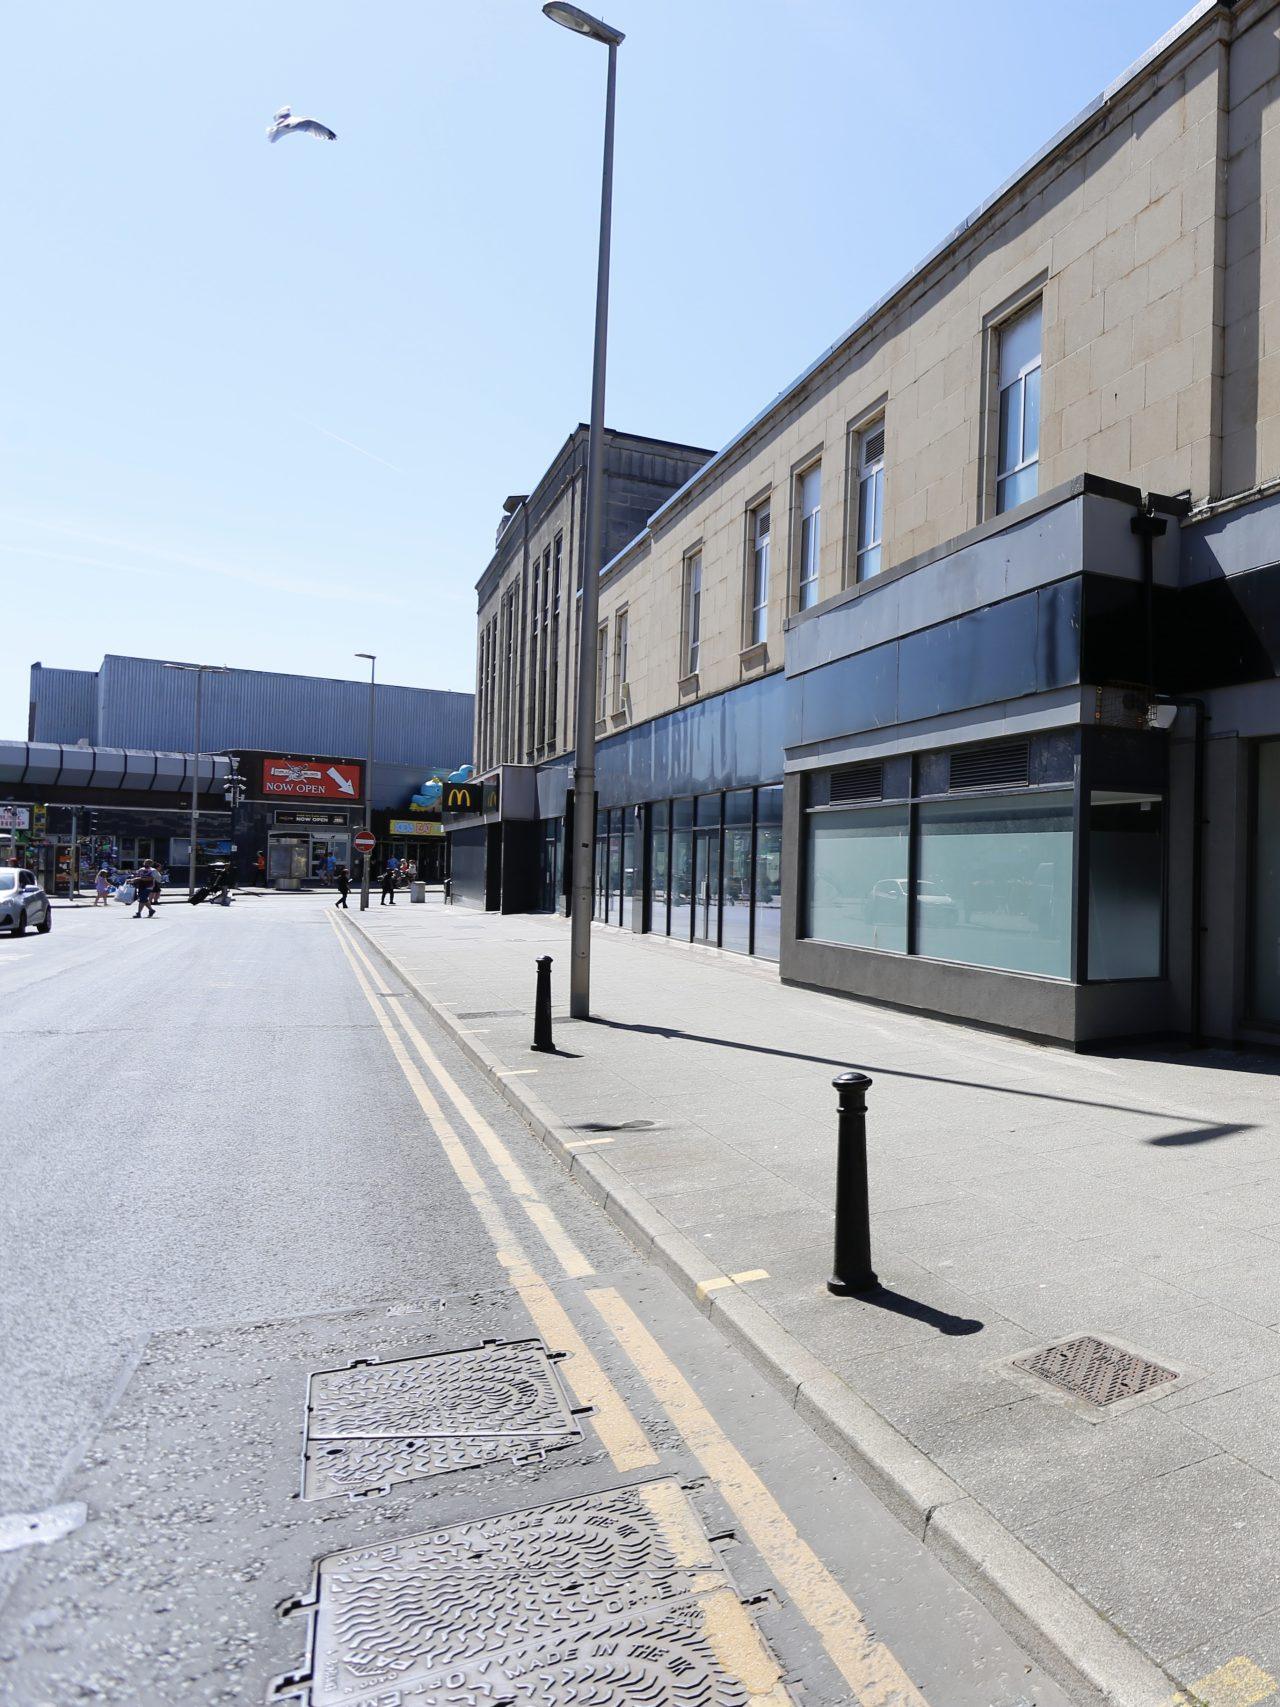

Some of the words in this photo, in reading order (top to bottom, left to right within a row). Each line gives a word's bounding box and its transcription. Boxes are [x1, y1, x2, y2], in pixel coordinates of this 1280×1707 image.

[266, 782, 293, 792] NOW
[296, 784, 326, 794] OPEN
[481, 1516, 544, 1539] MADE
[554, 1514, 577, 1524] IN
[584, 1515, 618, 1528] THE
[615, 1524, 640, 1539] UK
[503, 1647, 579, 1680] MADE
[591, 1643, 619, 1658] IN
[627, 1643, 670, 1662] THE
[666, 1656, 696, 1677] UK
